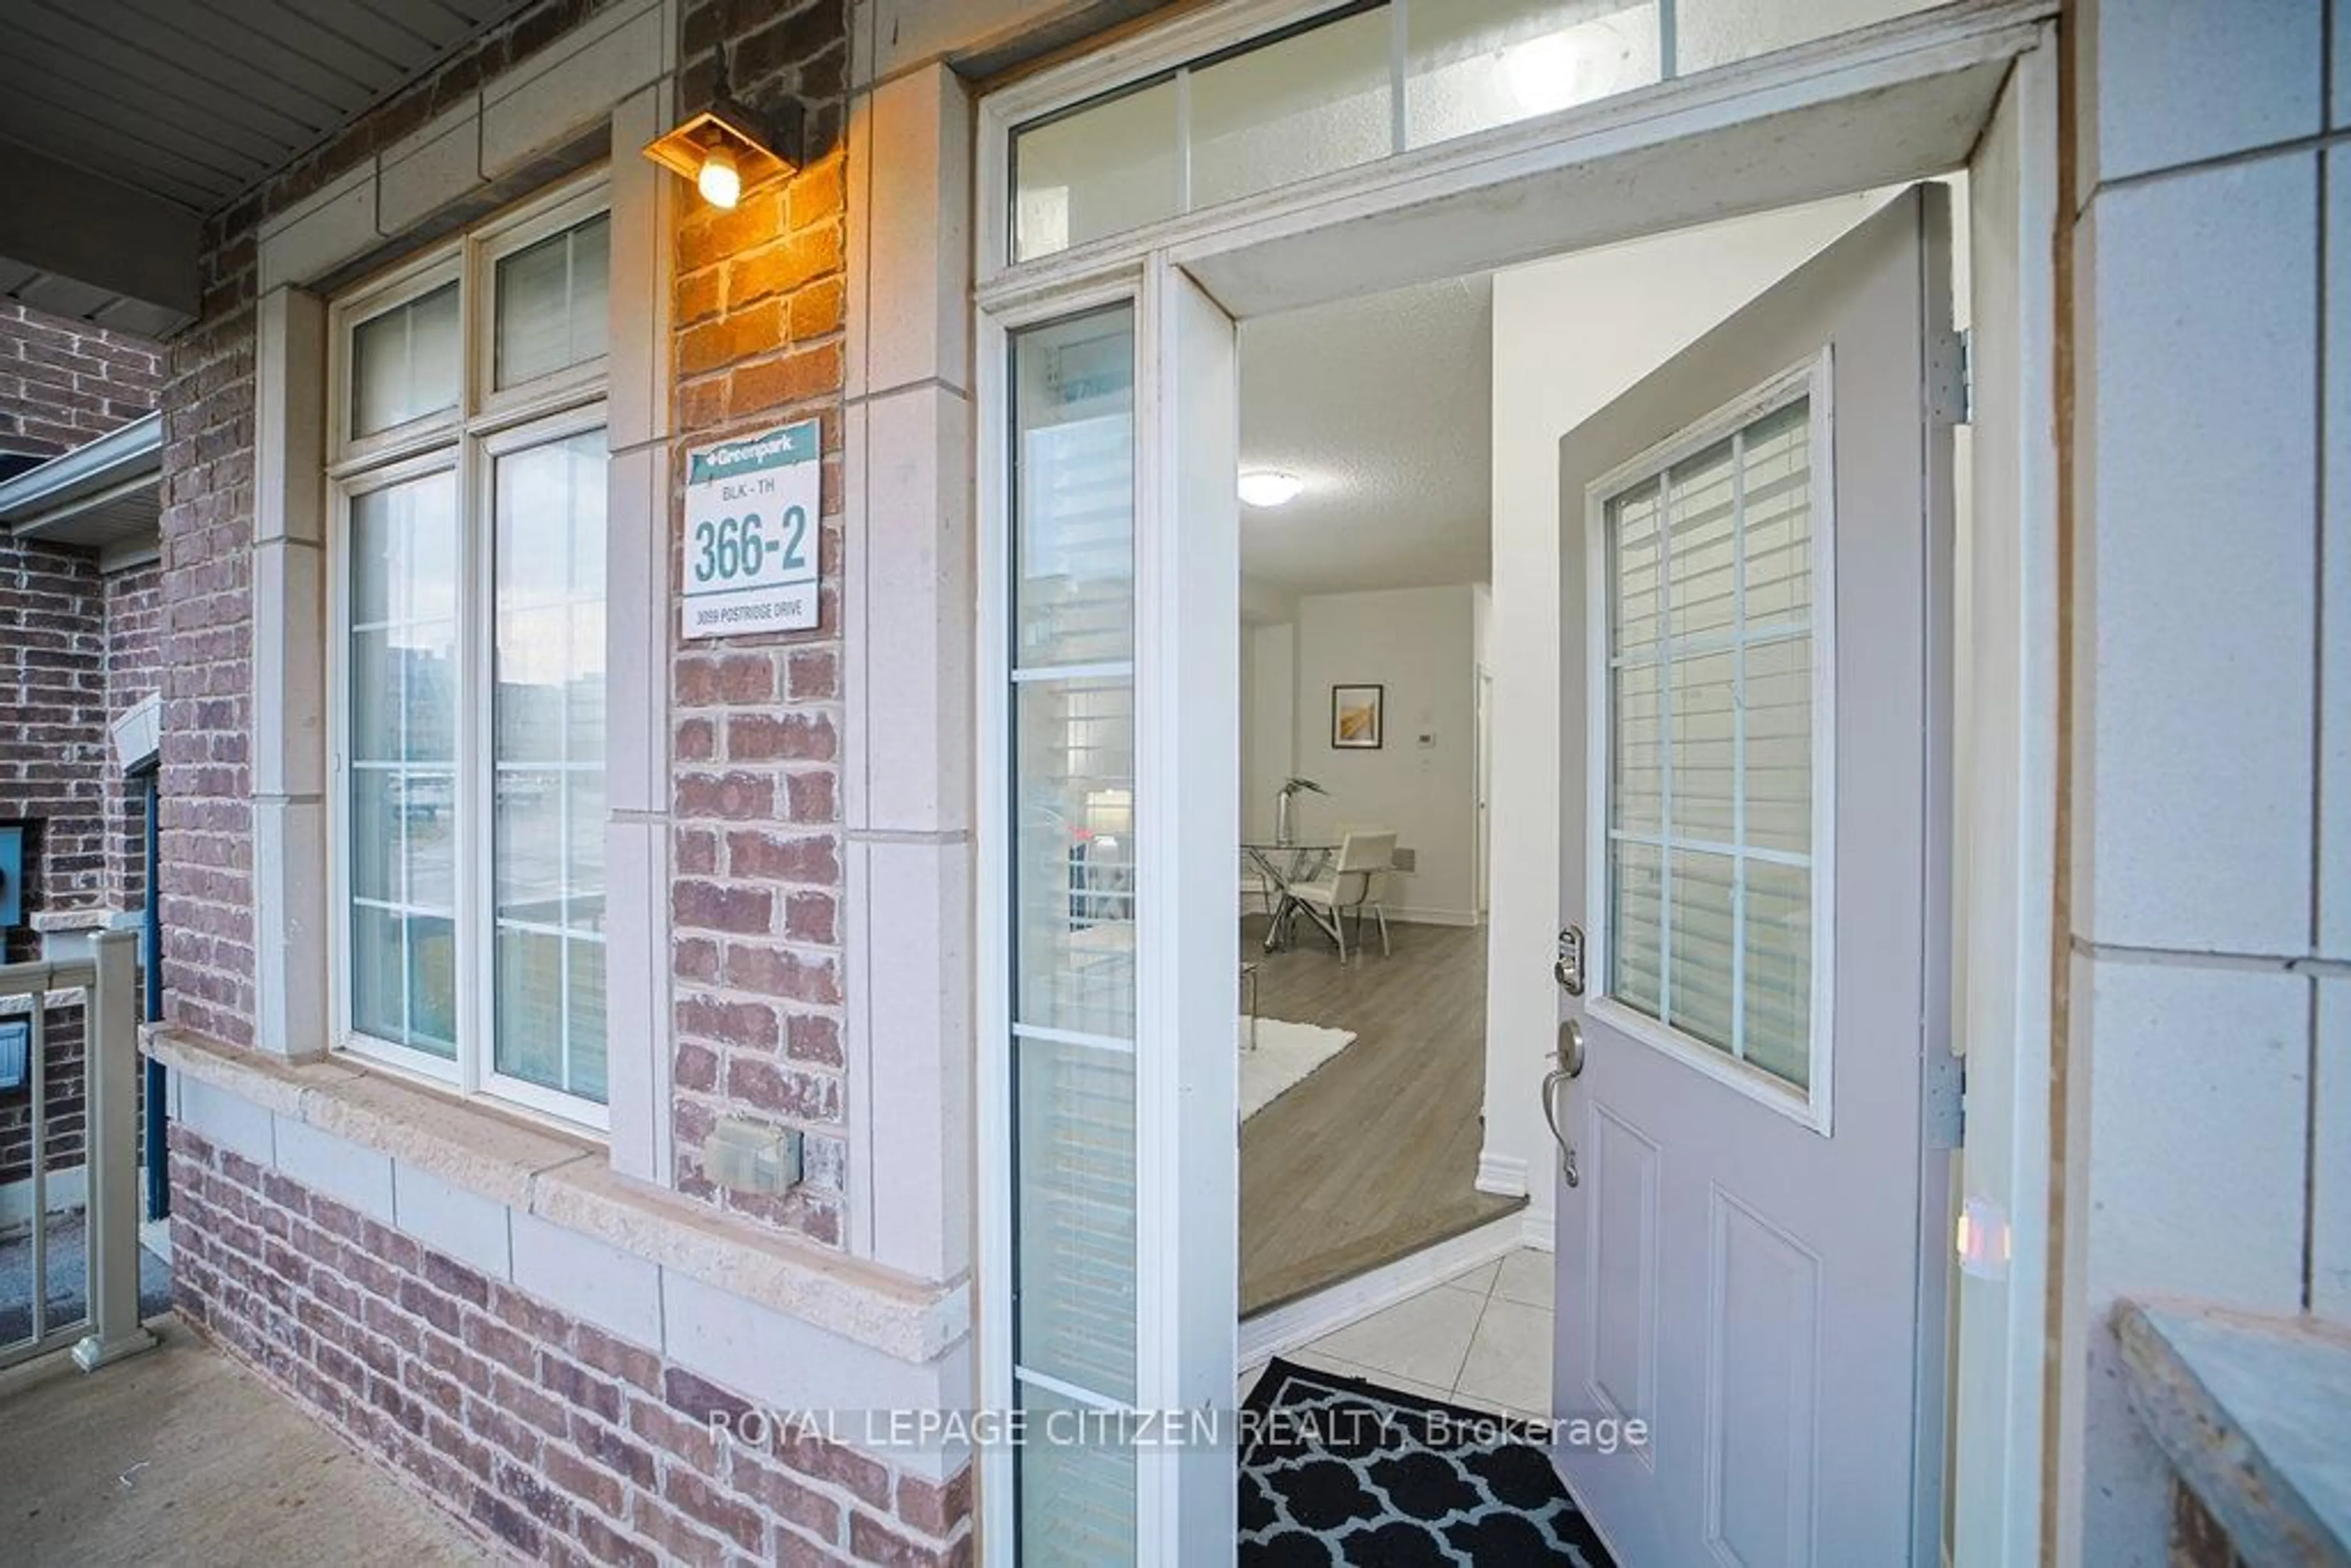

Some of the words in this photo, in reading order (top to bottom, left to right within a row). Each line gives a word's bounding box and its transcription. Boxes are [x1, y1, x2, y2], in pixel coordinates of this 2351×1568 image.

[723, 484, 747, 501] BLK
[757, 478, 774, 494] TH
[696, 505, 806, 581] 366-2
[774, 599, 802, 617] DRIVE
